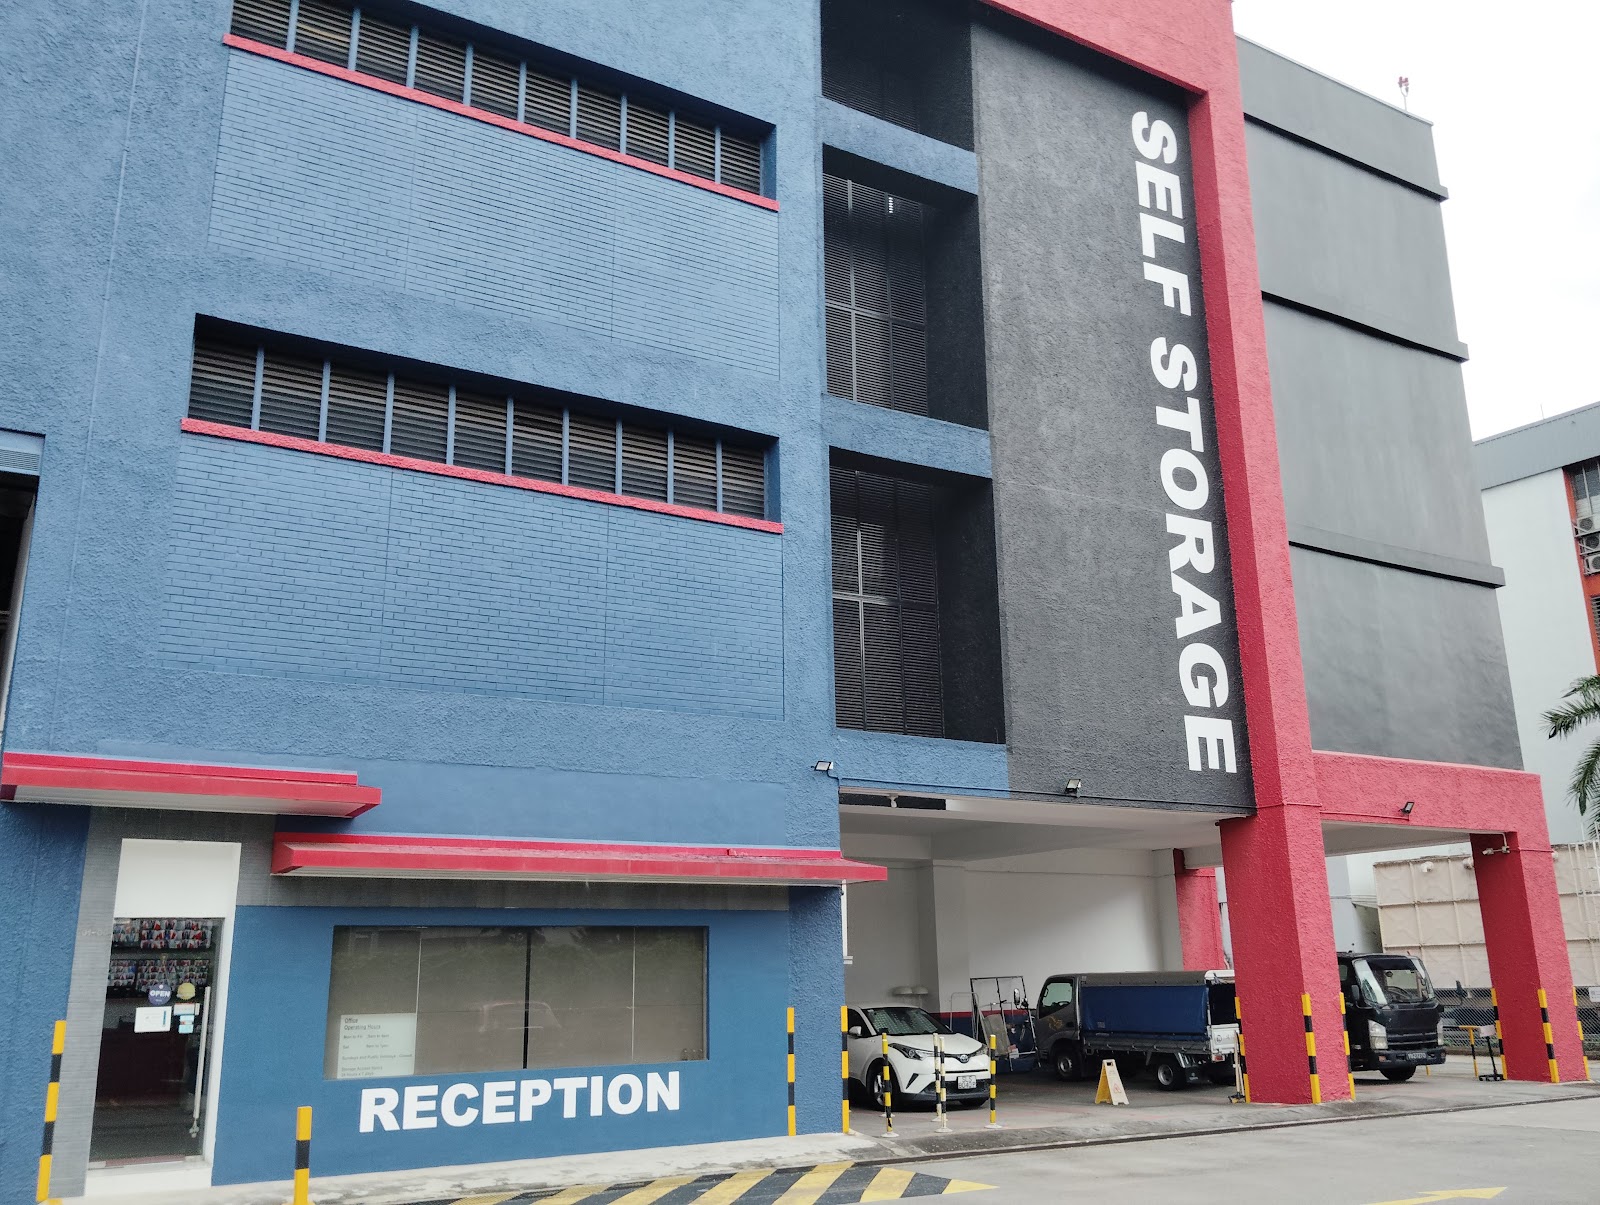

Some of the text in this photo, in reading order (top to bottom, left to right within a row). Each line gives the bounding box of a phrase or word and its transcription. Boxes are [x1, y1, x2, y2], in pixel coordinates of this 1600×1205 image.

[1131, 111, 1237, 773] SELF STORAGE
[359, 1071, 680, 1133] RECEPTION
